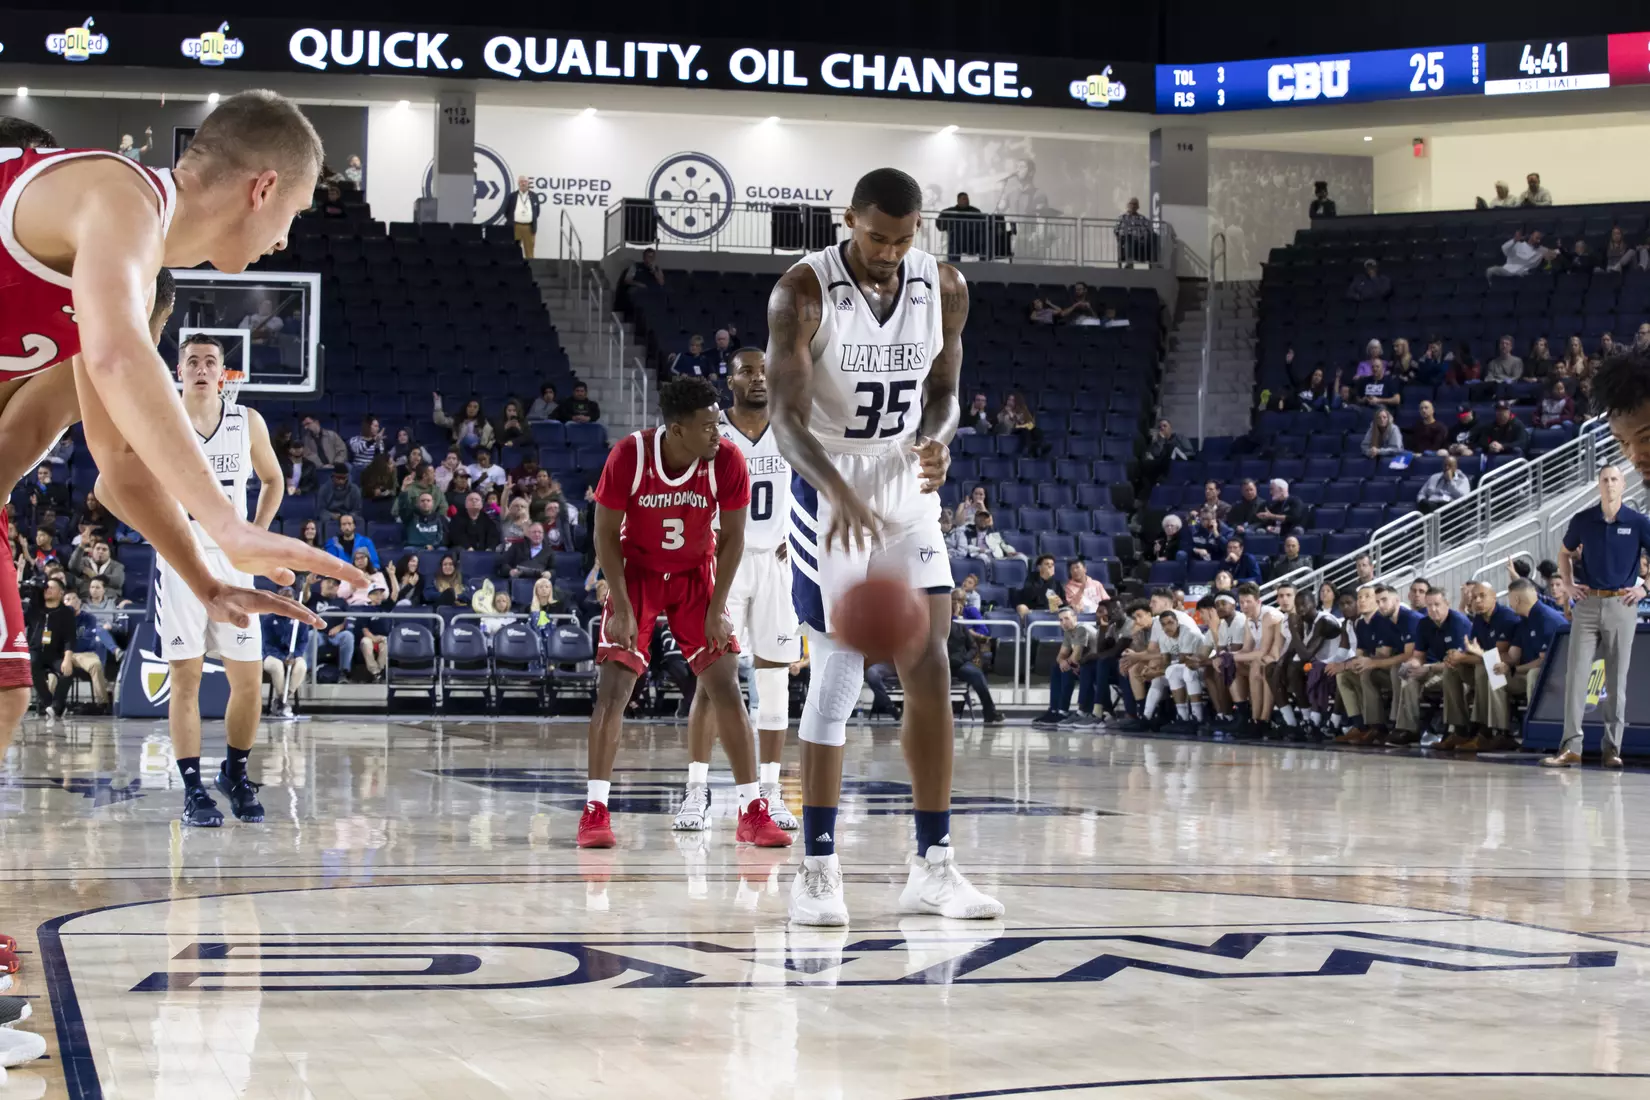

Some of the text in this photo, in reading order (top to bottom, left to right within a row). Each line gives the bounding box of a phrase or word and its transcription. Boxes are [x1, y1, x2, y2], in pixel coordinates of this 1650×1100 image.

[289, 27, 1032, 99] QUICK. QUALITY. OIL CHANGE.
[1409, 51, 1445, 92] 25
[1519, 42, 1568, 75] 4:41
[1173, 66, 1225, 86] TOL 3
[1267, 59, 1350, 102] CBU
[1174, 89, 1225, 108] FLS 3
[1177, 143, 1193, 152] 114
[528, 176, 611, 192] EQUIPPED
[553, 193, 609, 206] SERVE
[746, 186, 833, 201] GLOBALLY
[841, 342, 926, 373] LANCERS
[844, 379, 918, 439] 35
[638, 490, 709, 509] SOUTH DAKOTA
[751, 481, 773, 521] 0
[661, 518, 685, 550] 3
